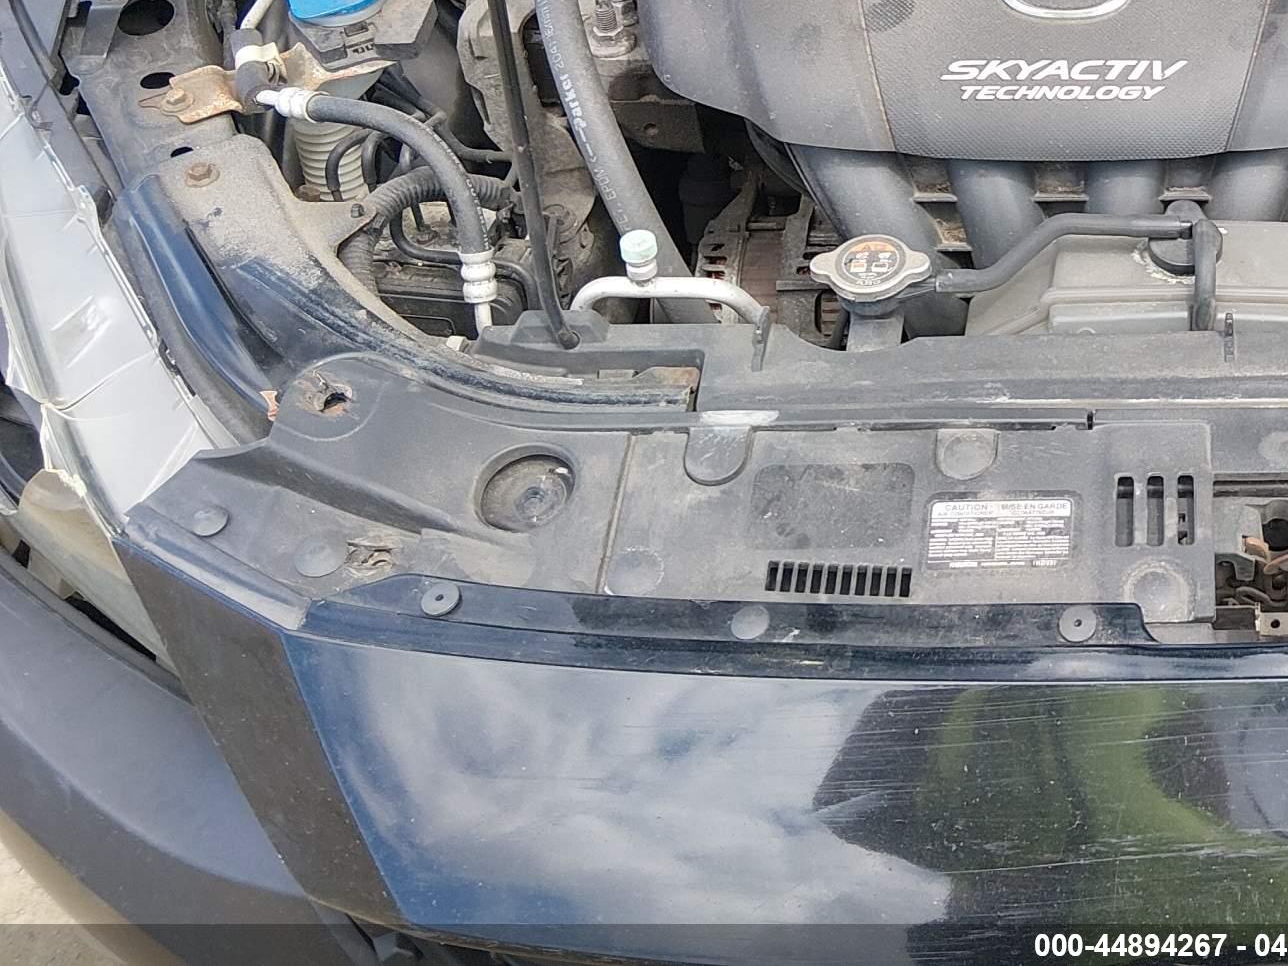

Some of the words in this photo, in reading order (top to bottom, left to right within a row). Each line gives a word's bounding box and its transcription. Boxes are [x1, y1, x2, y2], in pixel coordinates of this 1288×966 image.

[940, 59, 1188, 81] SKYACTIV
[560, 73, 587, 131] Parker
[961, 85, 1166, 101] TECHNOLOGY
